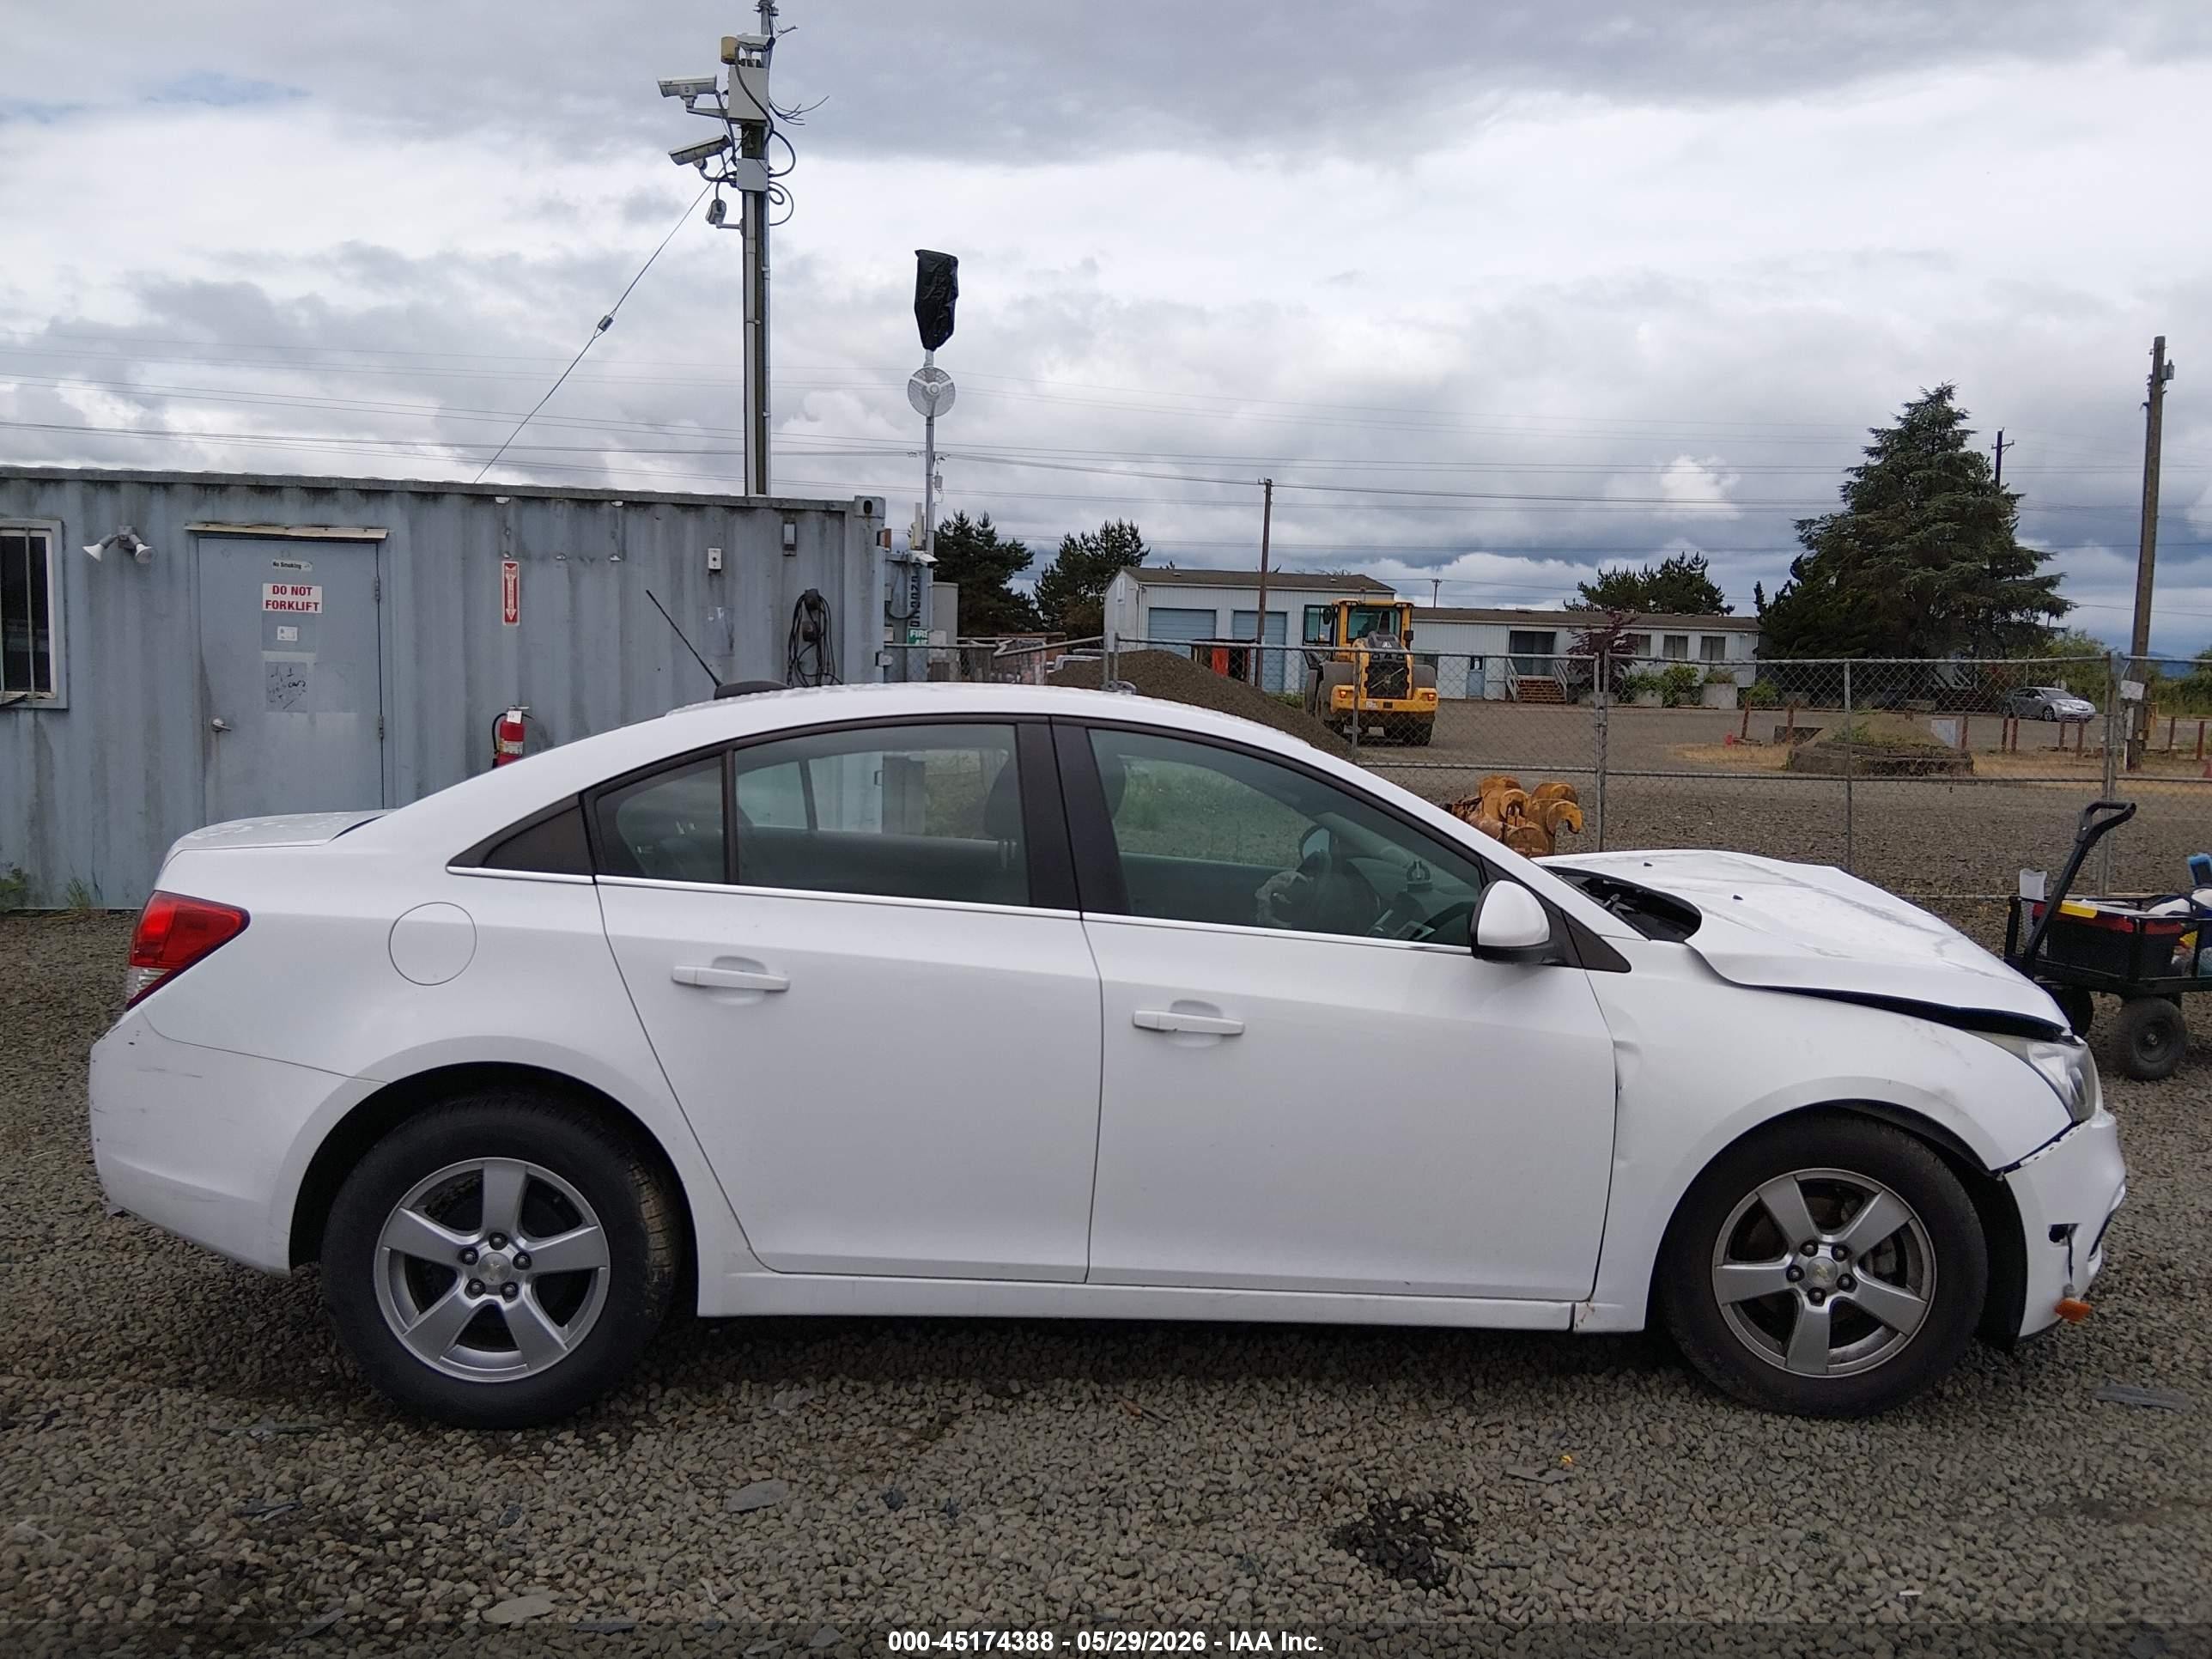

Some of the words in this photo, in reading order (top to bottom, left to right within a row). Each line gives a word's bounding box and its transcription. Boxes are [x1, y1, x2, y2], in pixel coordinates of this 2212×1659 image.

[272, 585, 287, 595] DO
[290, 586, 313, 596] NOT
[265, 599, 319, 611] FORKLIFT
